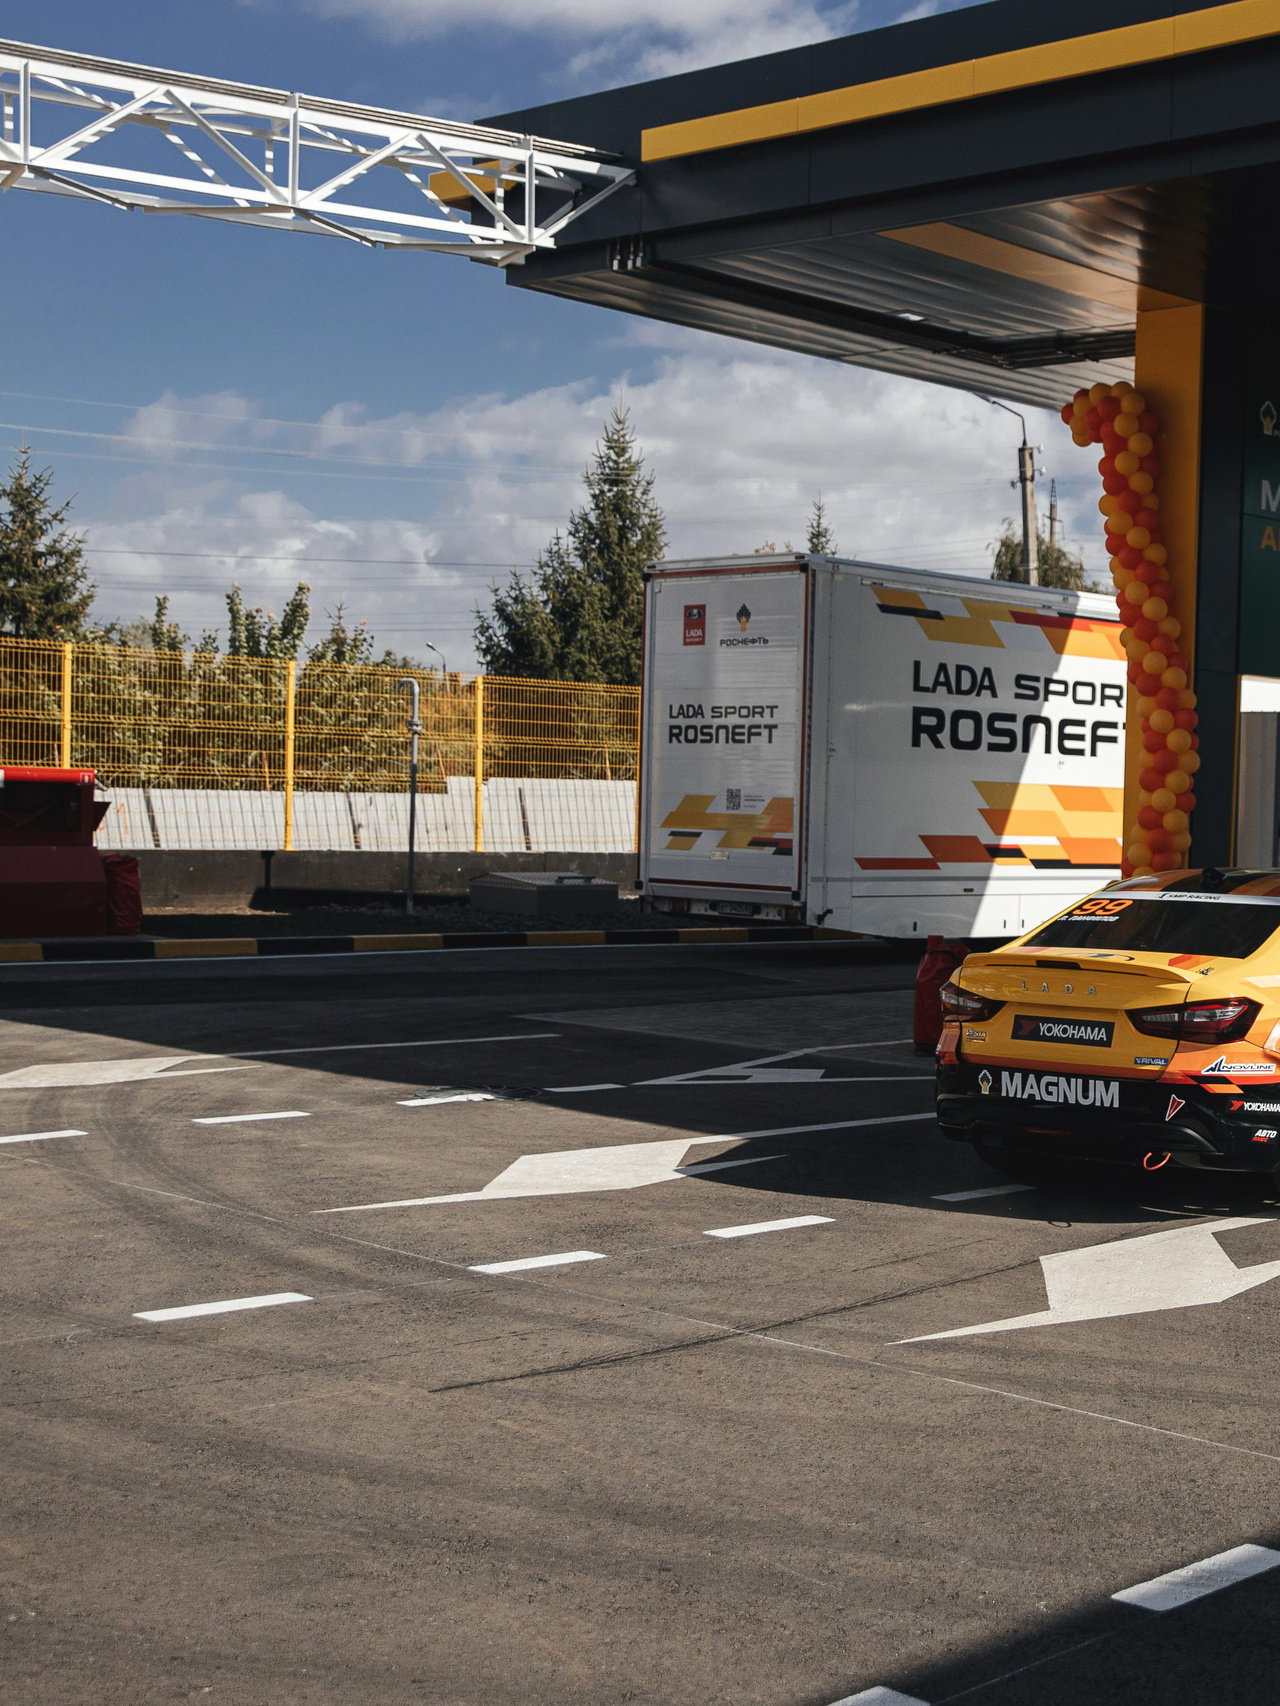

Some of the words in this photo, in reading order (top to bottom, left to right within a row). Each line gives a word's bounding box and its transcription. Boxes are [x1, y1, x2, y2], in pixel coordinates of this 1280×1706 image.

[686, 629, 703, 637] LADA
[720, 636, 770, 647] РОСНЕФТЬ
[913, 660, 998, 699] LADA
[1014, 673, 1125, 708] SPOR
[669, 704, 706, 719] LADA
[711, 705, 779, 719] SPORT
[668, 724, 778, 744] ROSNEFT
[911, 706, 1126, 757] ROSNEF
[1072, 899, 1134, 915] 99
[1021, 981, 1097, 995] LADA
[1039, 1023, 1107, 1041] YOKOHAMA
[1001, 1071, 1120, 1108] MAGNUM
[1243, 1102, 1280, 1112] YOKOHAMA
[1255, 1129, 1277, 1138] АВТО
